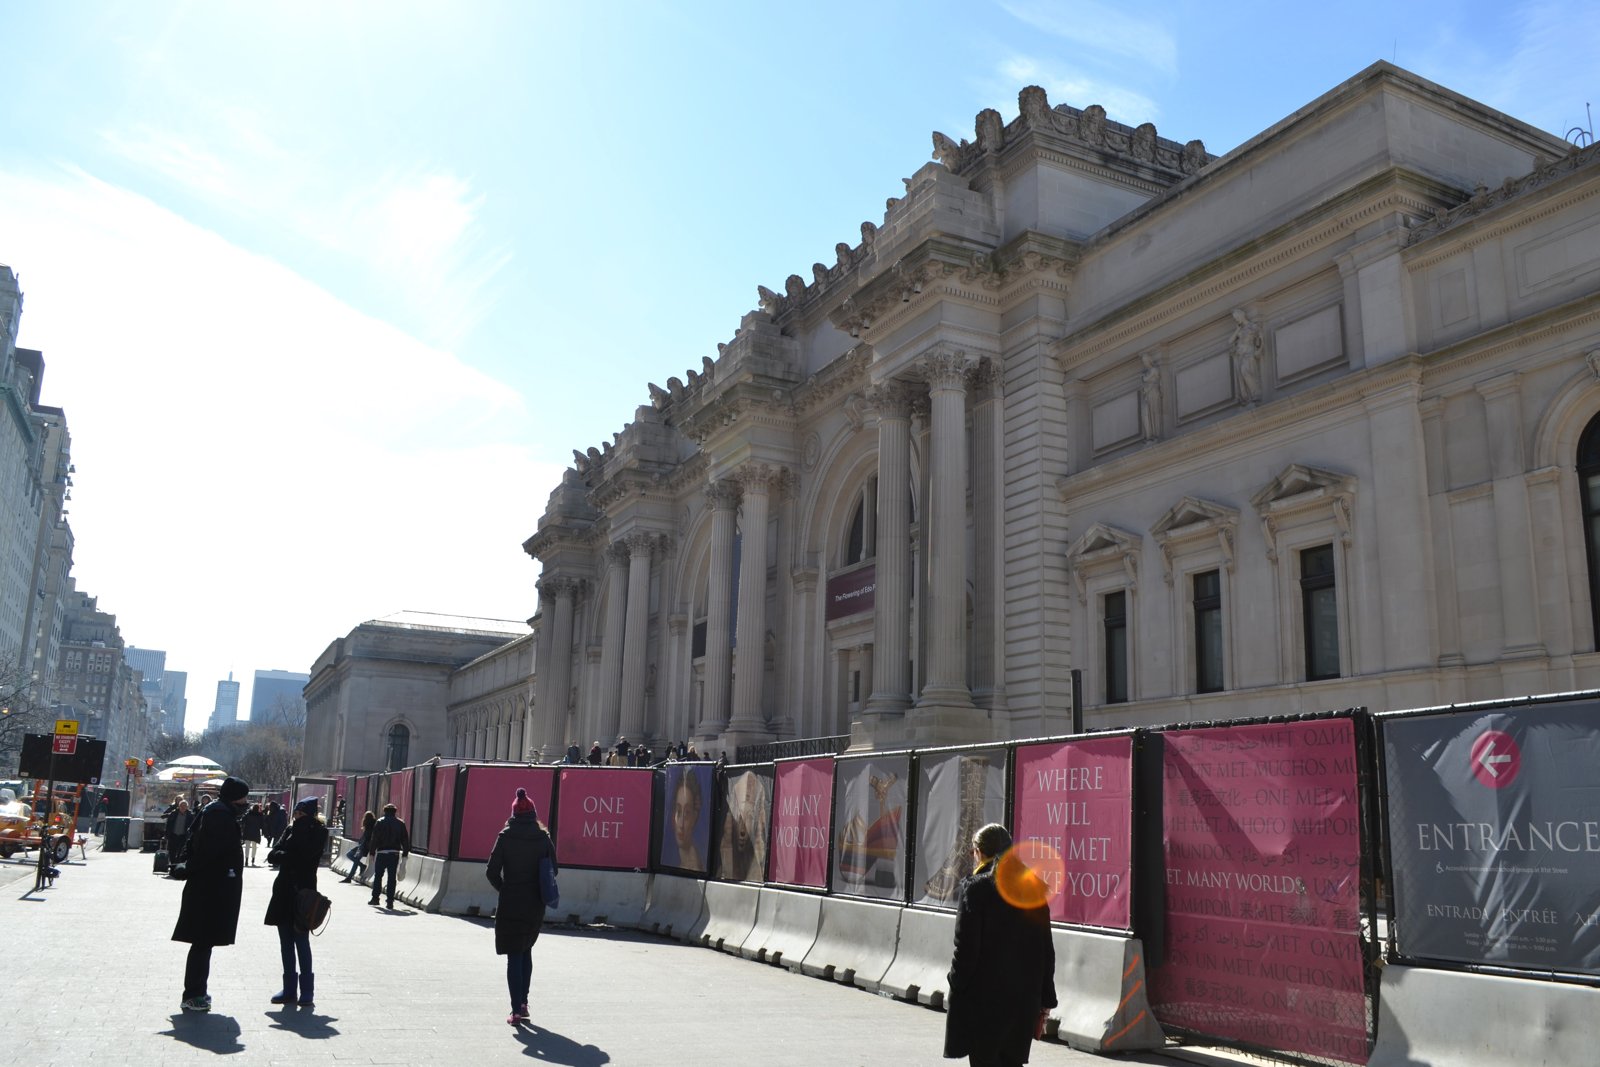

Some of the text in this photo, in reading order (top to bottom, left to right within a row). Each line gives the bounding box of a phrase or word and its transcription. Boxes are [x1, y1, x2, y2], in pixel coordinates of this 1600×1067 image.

[1254, 758, 1328, 777] MUCHOS
[1037, 767, 1103, 792] WHERE
[583, 796, 625, 814] ONE
[782, 794, 822, 816] MANY
[1255, 788, 1290, 807] ONE
[1046, 802, 1091, 825] WILL
[583, 821, 623, 838] MET
[775, 826, 826, 848] WORLDS
[1417, 821, 1600, 852] ENTRANCE
[1029, 837, 1111, 861] THE MET
[1068, 873, 1120, 899] YOU?
[1187, 869, 1232, 889] MANY
[1427, 904, 1489, 921] ENTRADA
[1260, 963, 1335, 989] MUCHOS
